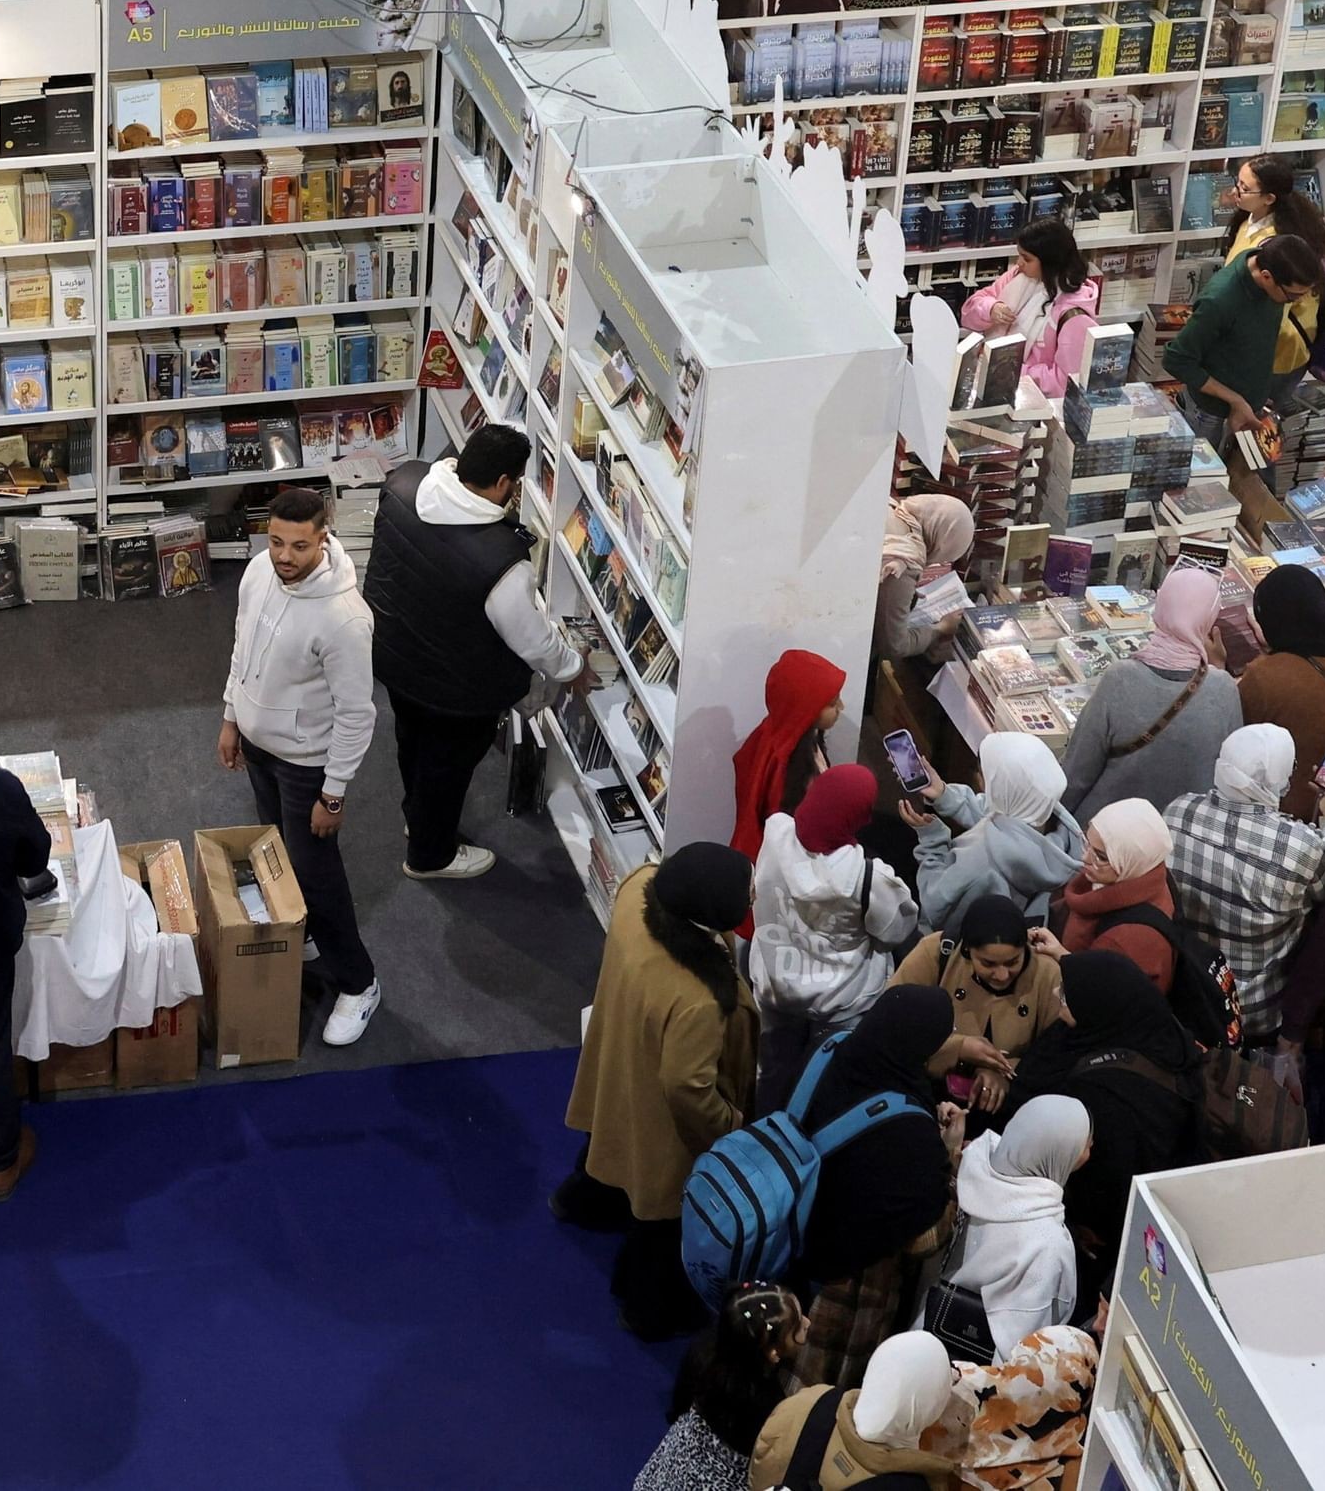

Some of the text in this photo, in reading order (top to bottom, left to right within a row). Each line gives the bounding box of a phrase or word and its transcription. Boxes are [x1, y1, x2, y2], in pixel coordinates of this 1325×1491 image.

[127, 28, 152, 43] A5
[176, 16, 360, 41] مكتبة رسالتنا للنشر والتوزيع
[1138, 1265, 1164, 1310] A2
